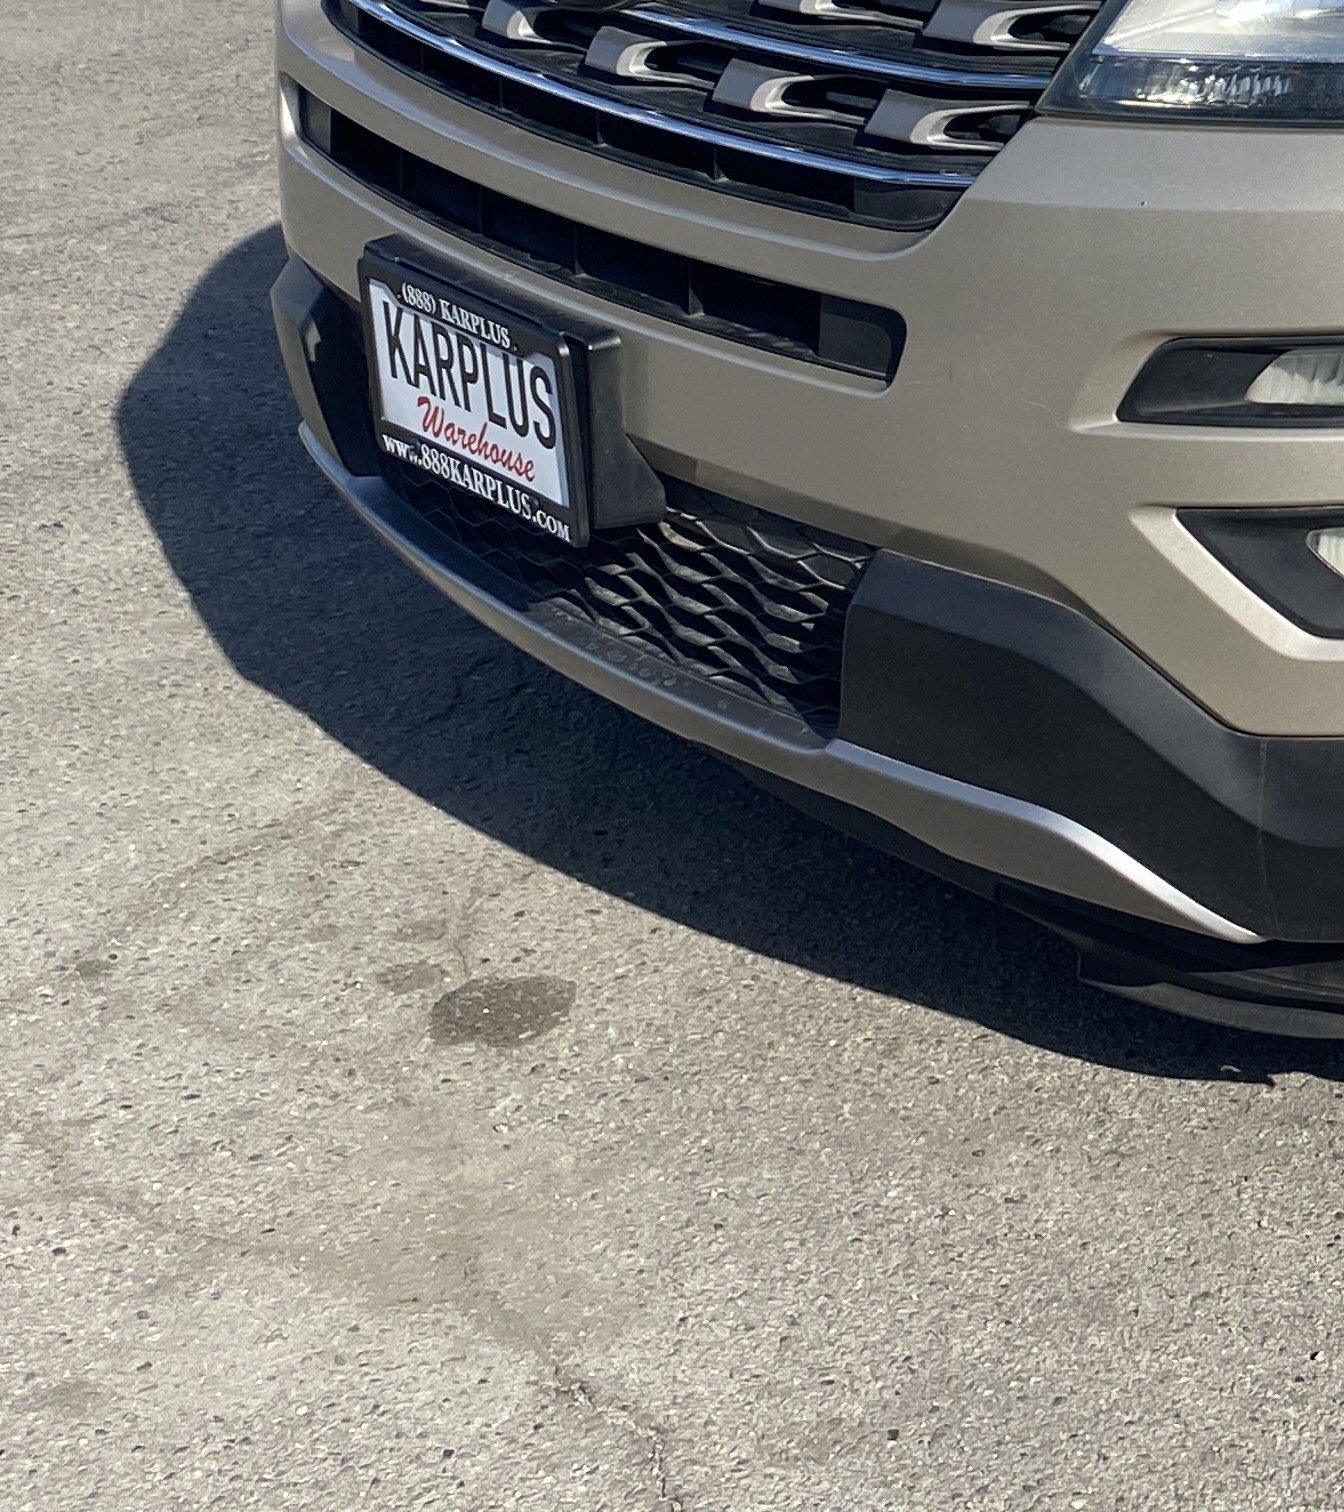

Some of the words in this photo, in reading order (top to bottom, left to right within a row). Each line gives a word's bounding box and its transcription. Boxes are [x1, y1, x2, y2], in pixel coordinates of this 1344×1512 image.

[401, 282, 437, 315] (888)
[438, 298, 511, 349] KARPLUS
[382, 299, 557, 450] KARPLUS
[416, 396, 536, 483] Warehouse
